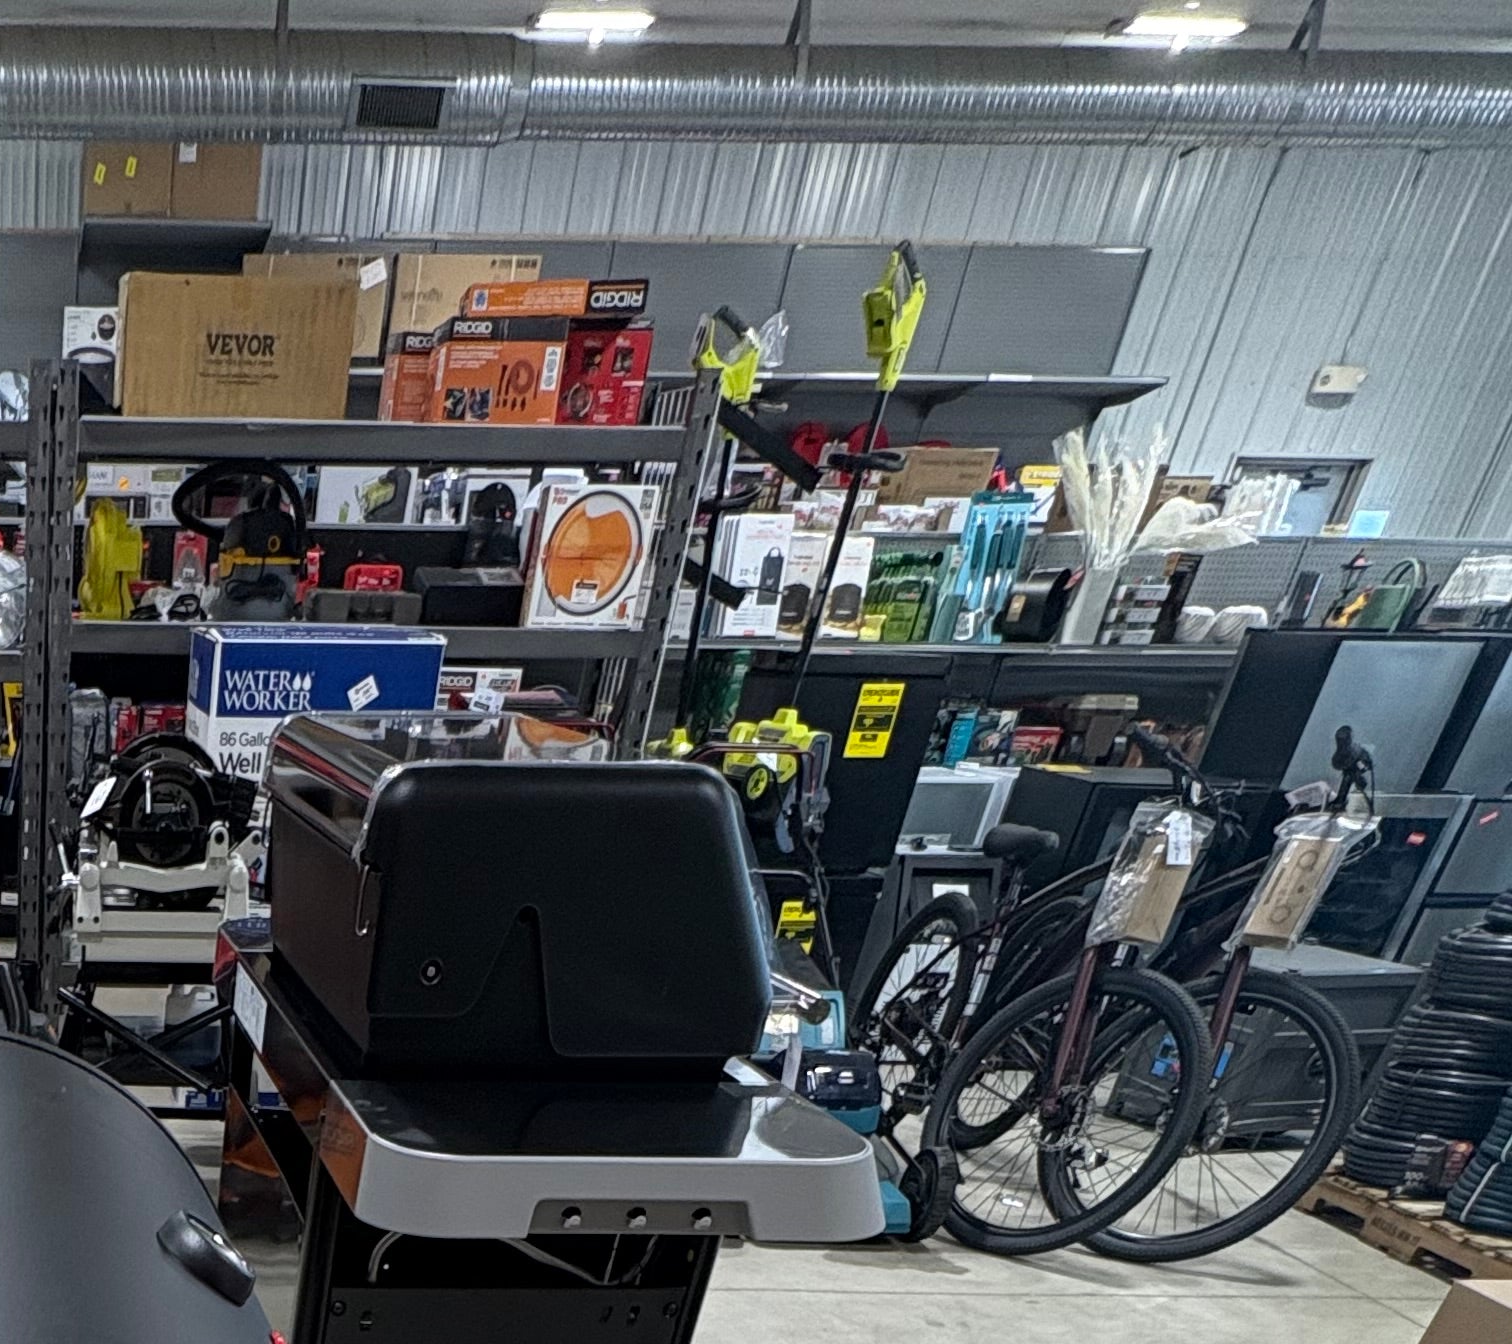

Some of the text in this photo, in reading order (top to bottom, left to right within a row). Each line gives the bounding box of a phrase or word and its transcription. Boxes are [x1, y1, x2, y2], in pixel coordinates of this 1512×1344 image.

[590, 289, 643, 308] RIDGID
[453, 320, 493, 335] RIDGID
[206, 333, 275, 357] VEVOR
[405, 335, 434, 349] RIDG
[224, 669, 291, 691] WATER
[224, 691, 312, 711] WORKER
[219, 731, 270, 747] 86 Gallo
[219, 752, 262, 775] Well
